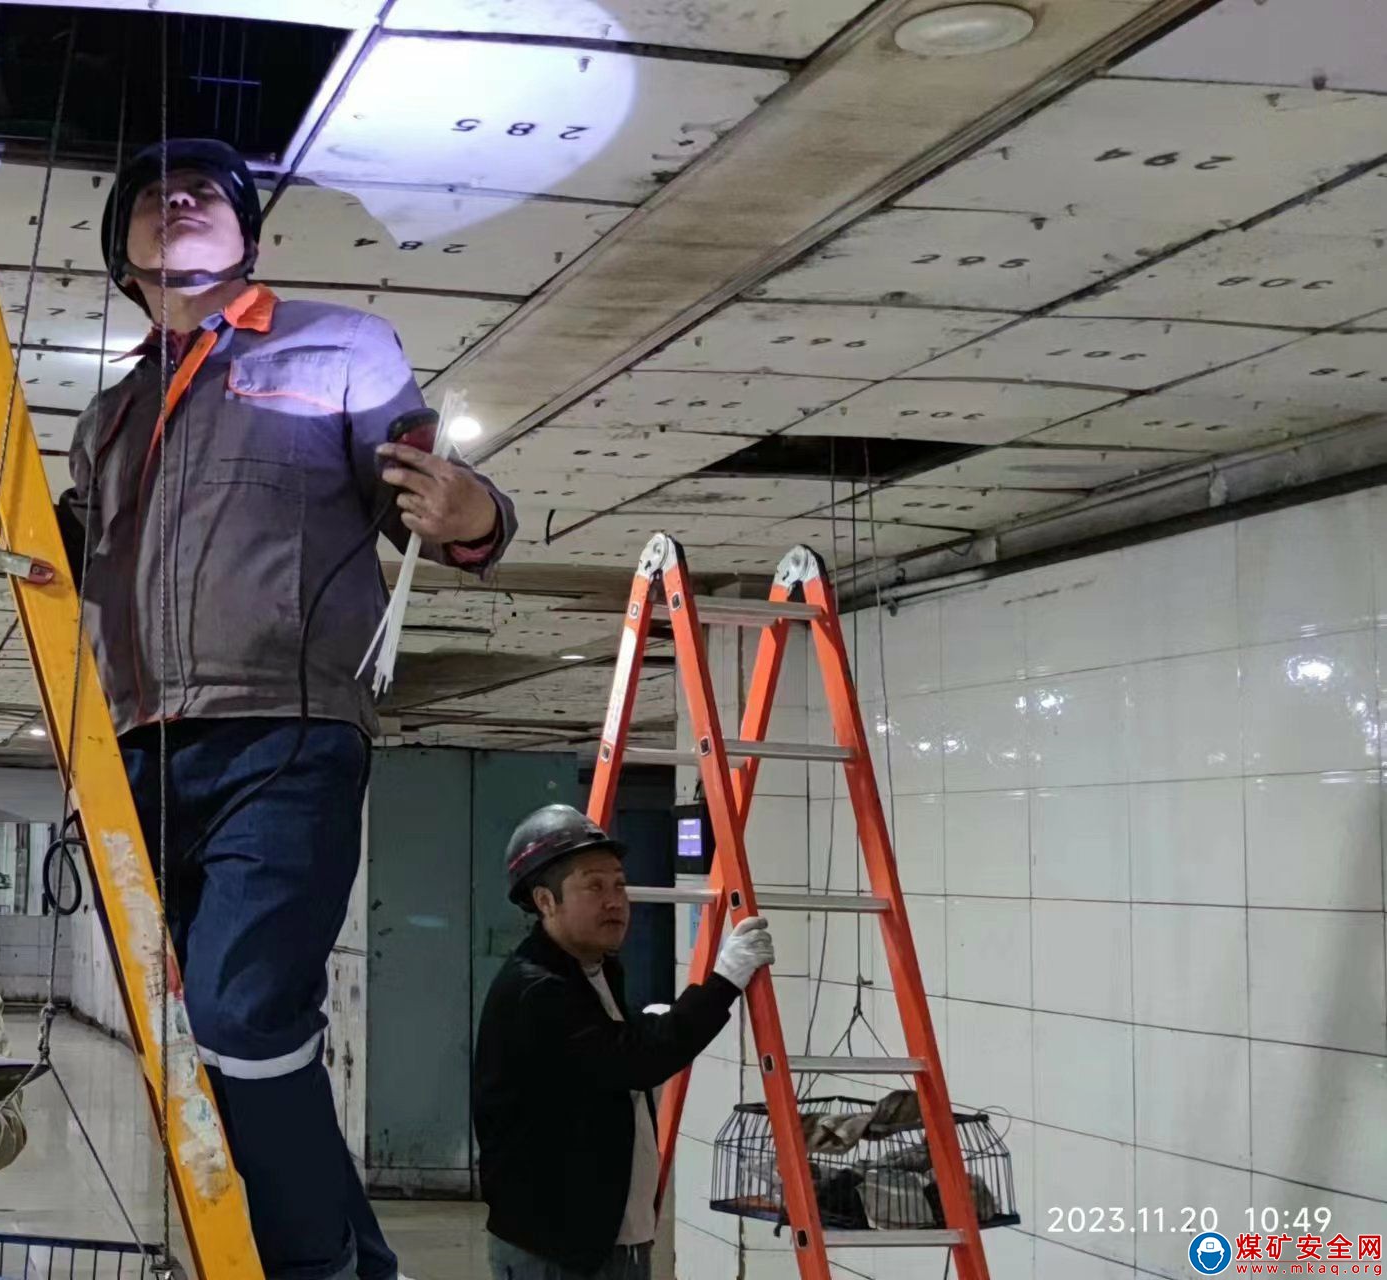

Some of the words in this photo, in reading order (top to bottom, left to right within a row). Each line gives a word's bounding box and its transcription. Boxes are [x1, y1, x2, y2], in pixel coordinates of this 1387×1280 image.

[451, 118, 589, 141] 285
[1093, 147, 1235, 171] 294
[353, 237, 468, 254] 284
[910, 253, 1030, 269] 295
[1216, 276, 1334, 290] 308
[769, 335, 867, 349] 296
